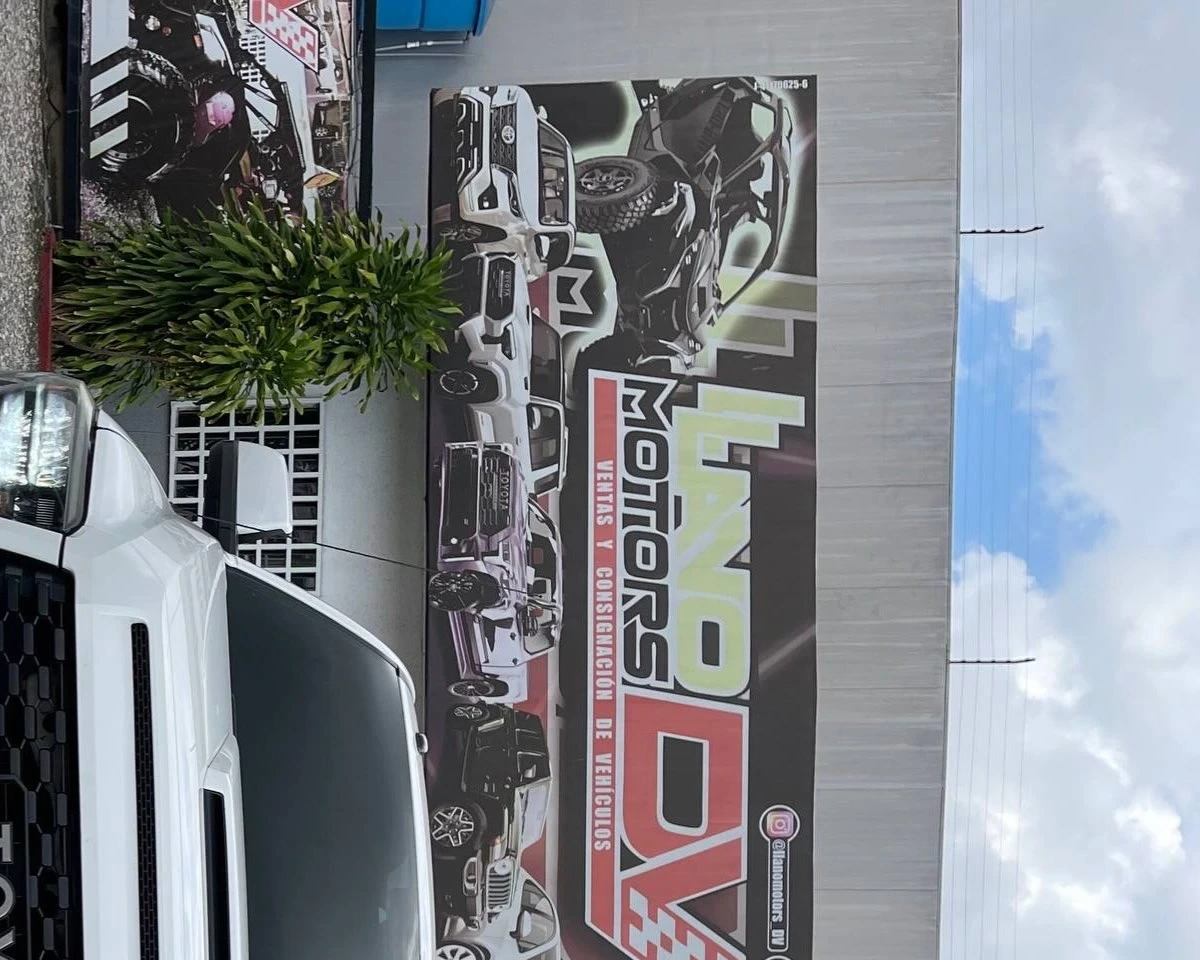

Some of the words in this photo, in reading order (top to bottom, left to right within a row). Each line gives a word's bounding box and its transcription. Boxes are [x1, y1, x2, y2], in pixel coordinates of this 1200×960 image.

[499, 470, 510, 512] TOYOTA
[596, 460, 613, 526] VENTAS
[596, 539, 613, 550] Y
[621, 379, 670, 687] MOTORS
[595, 566, 617, 701] CONSIGNACIÓN
[594, 717, 612, 740] DE
[593, 753, 615, 852] VEHÍCULOS
